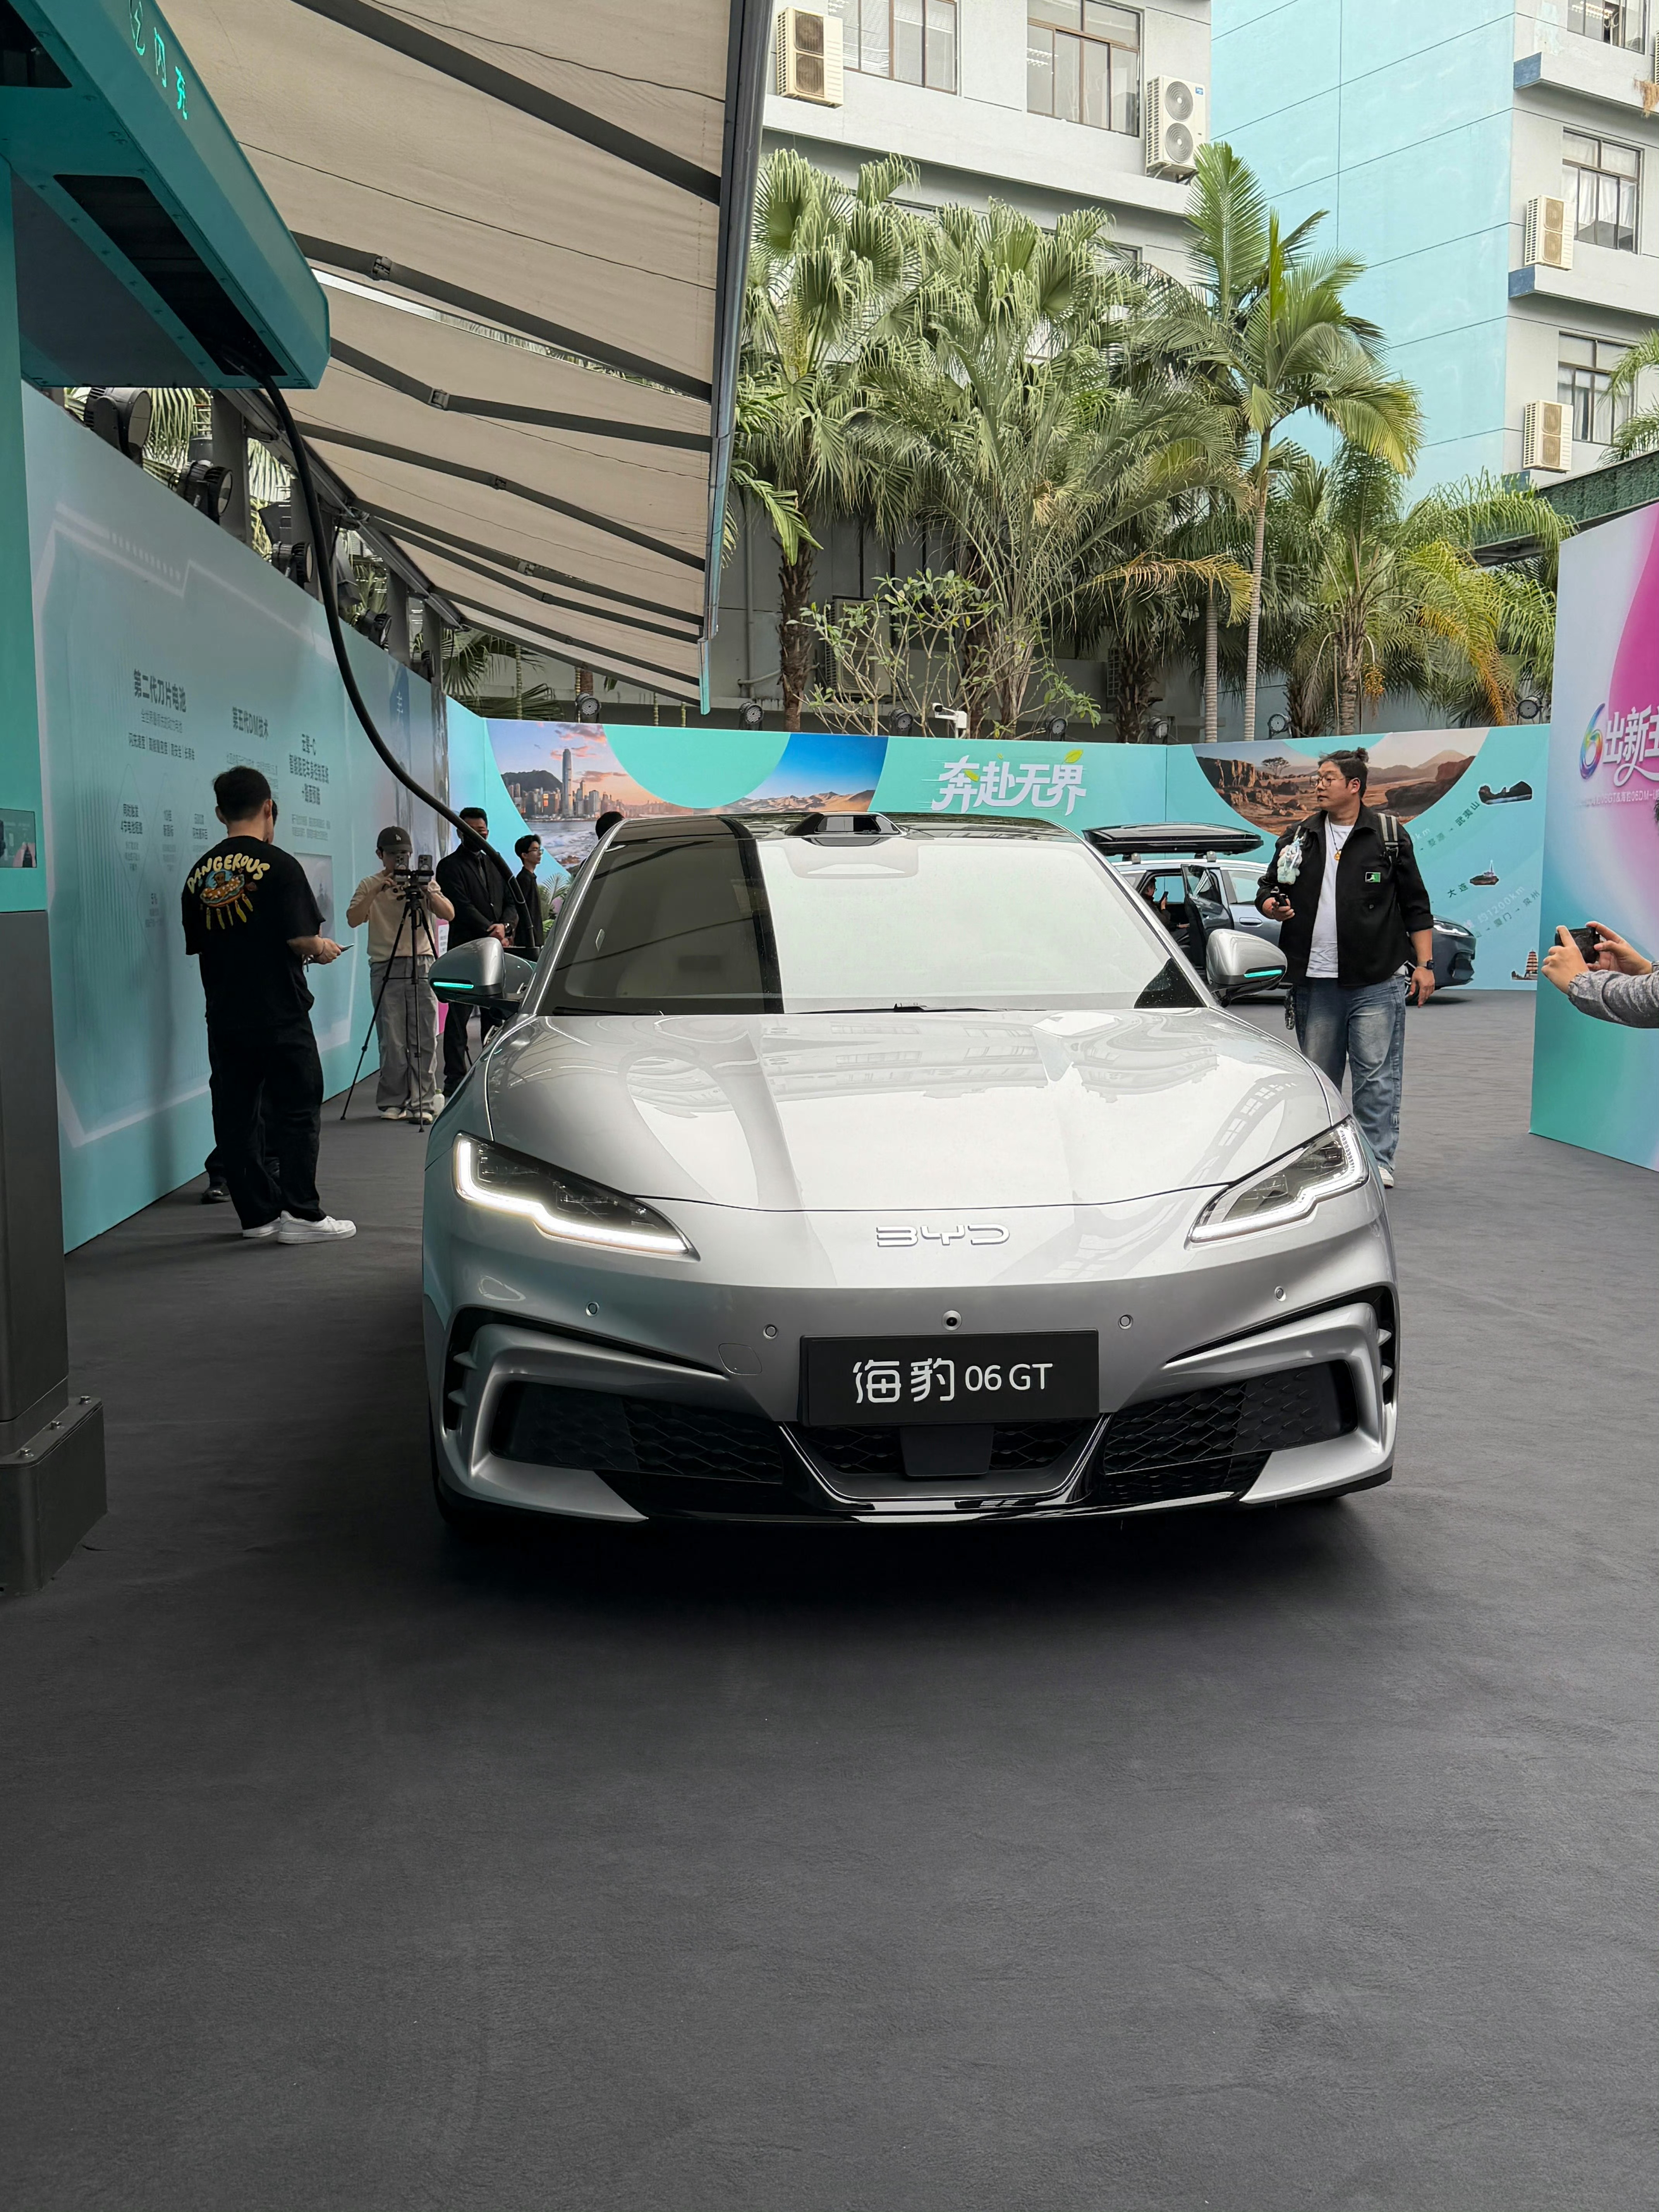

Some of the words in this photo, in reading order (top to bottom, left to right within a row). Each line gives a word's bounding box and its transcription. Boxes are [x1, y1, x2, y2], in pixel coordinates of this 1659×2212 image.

[134, 669, 186, 712] 第二代刀片电池
[931, 755, 1086, 816] 奔赴无界
[1455, 801, 1480, 826] 武夷山
[187, 853, 270, 894] DANGEROUS
[876, 1223, 1010, 1247] BYD
[1009, 1363, 1053, 1390] GT
